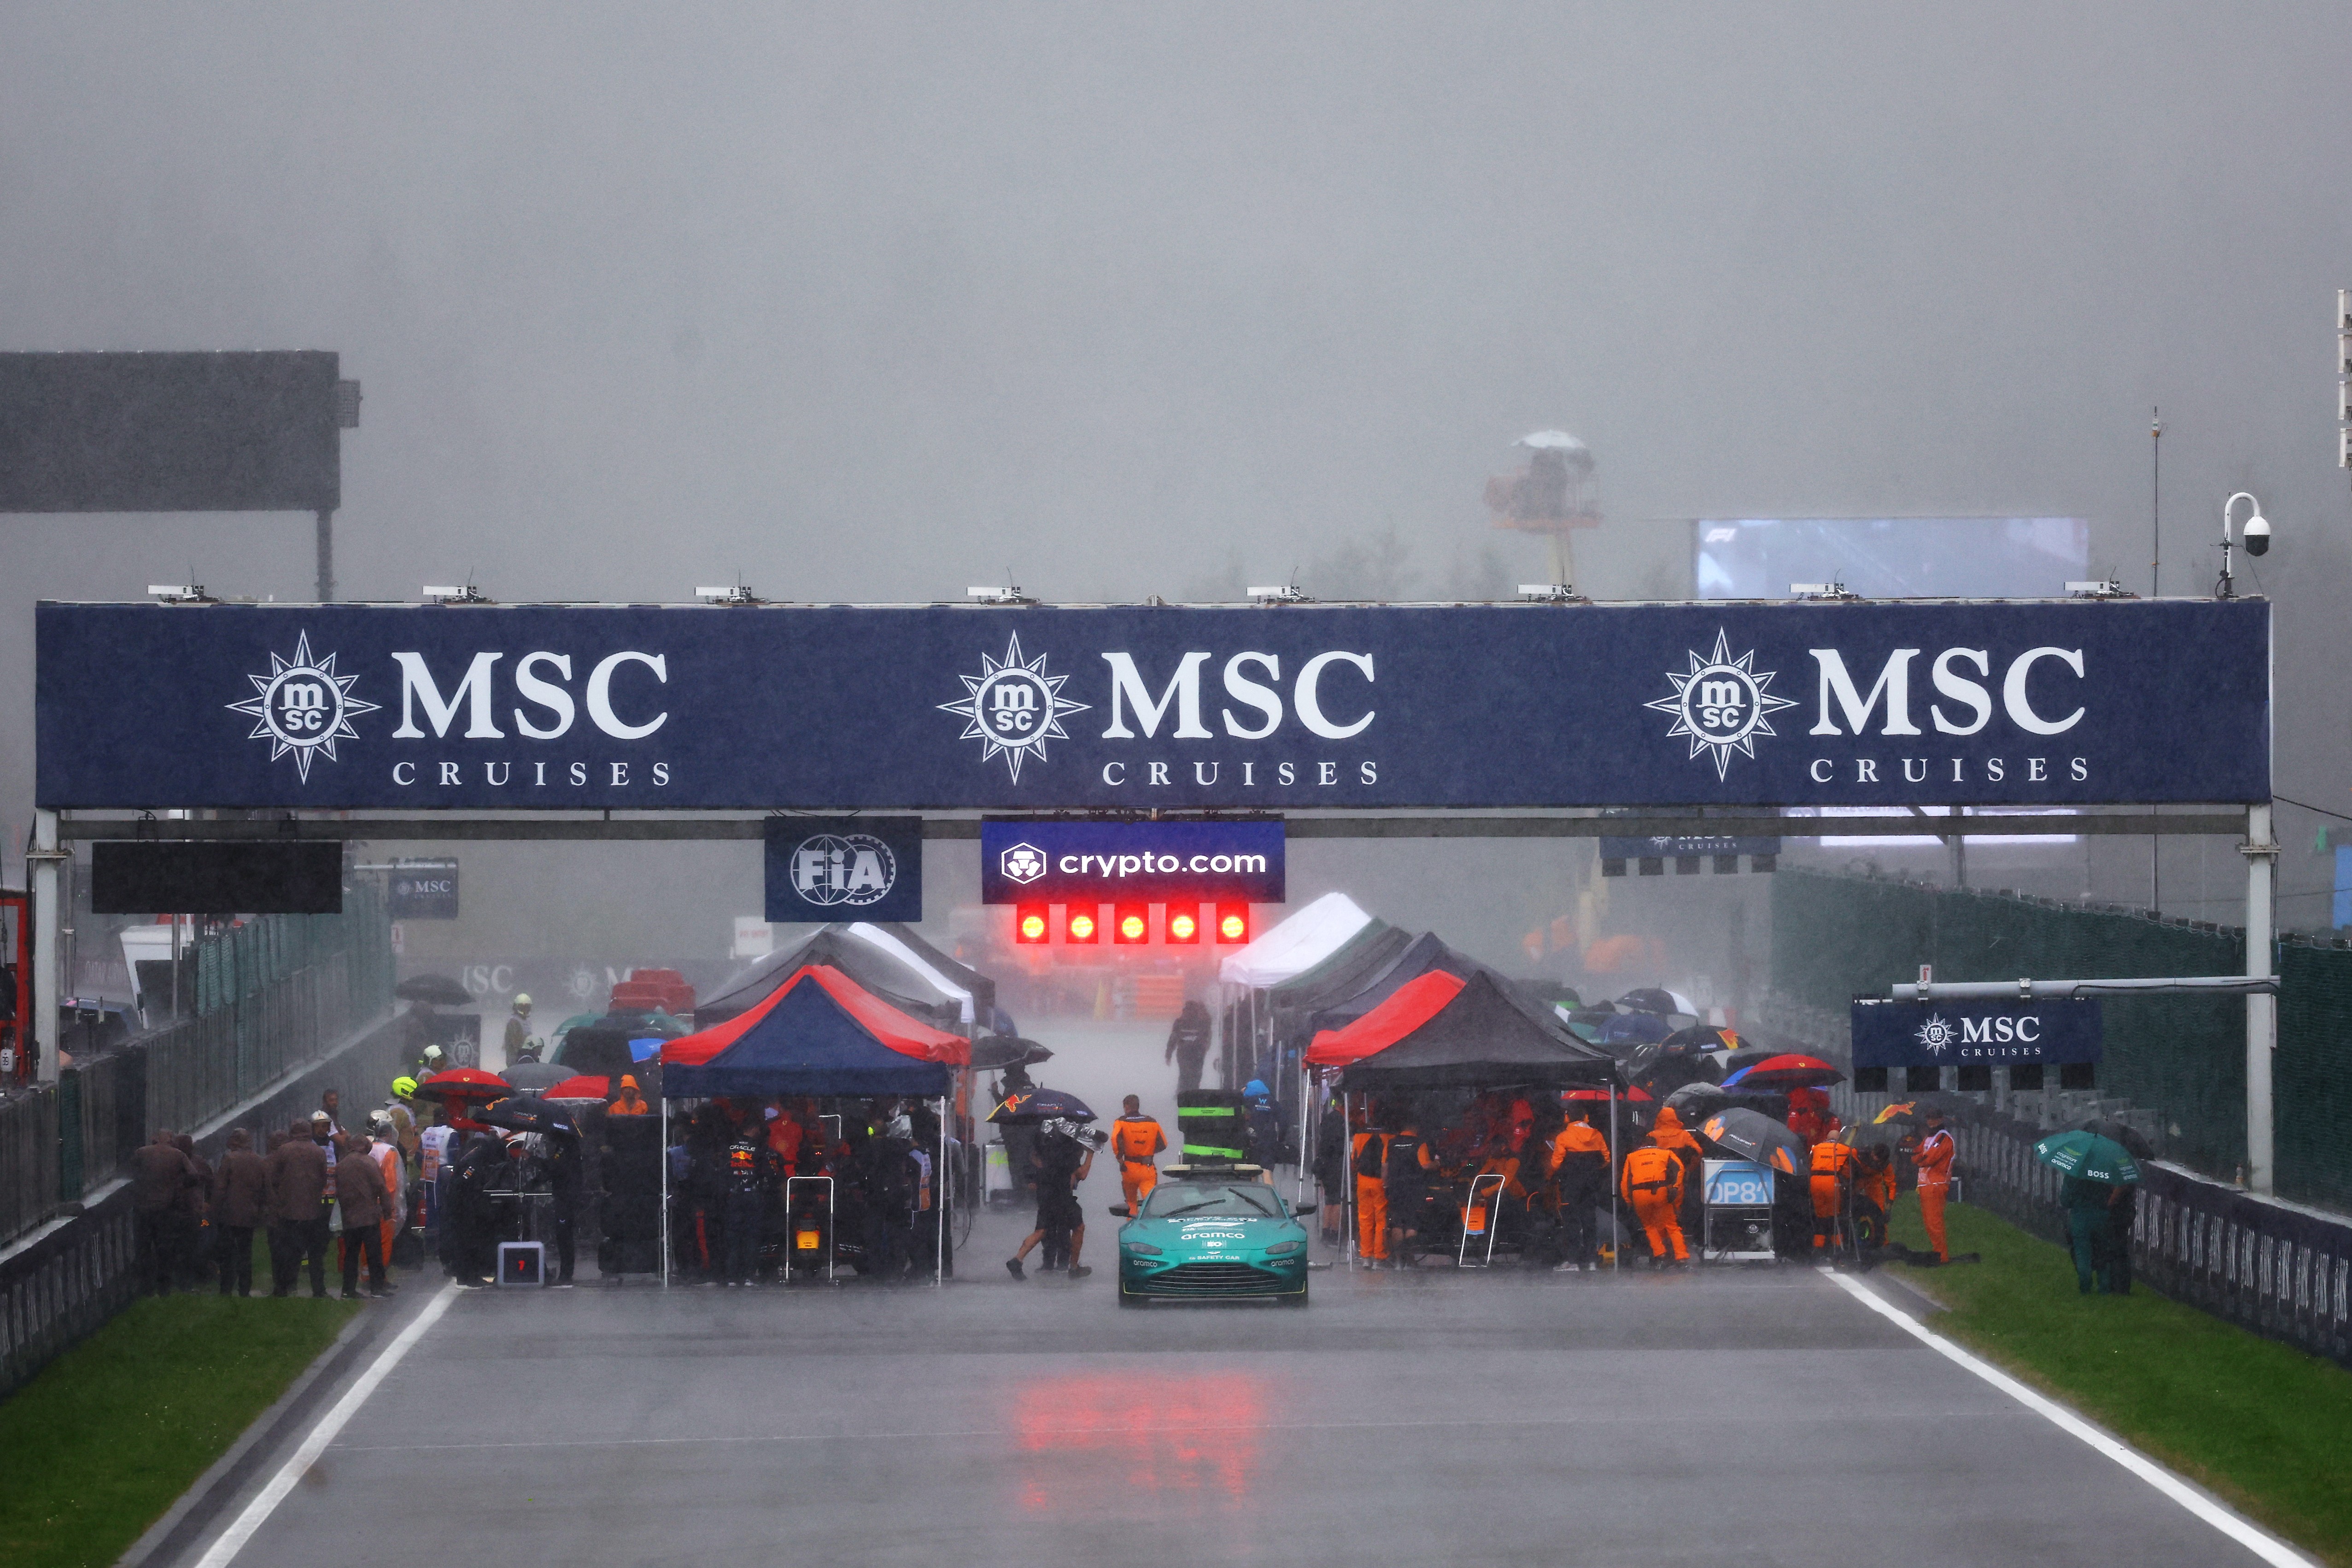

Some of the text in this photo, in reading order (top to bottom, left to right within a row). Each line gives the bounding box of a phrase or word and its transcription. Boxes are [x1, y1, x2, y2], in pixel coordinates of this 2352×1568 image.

[392, 651, 667, 739] MSC
[1101, 650, 1375, 739] MSC
[1808, 646, 2085, 736] MSC
[393, 762, 670, 786] CRUISES
[1103, 761, 1377, 786] CRUISES
[1810, 757, 2087, 783] CRUISES
[1060, 851, 1266, 878] crypto.com
[415, 880, 451, 893] MSC
[462, 965, 513, 994] SC
[1960, 1016, 2040, 1043] MSC
[1961, 1047, 2041, 1056] CRUISES
[2038, 1143, 2048, 1154] BOSS
[2051, 1158, 2071, 1170] aramco
[2088, 1170, 2109, 1179] BOSS
[1271, 1258, 1294, 1267] aramco
